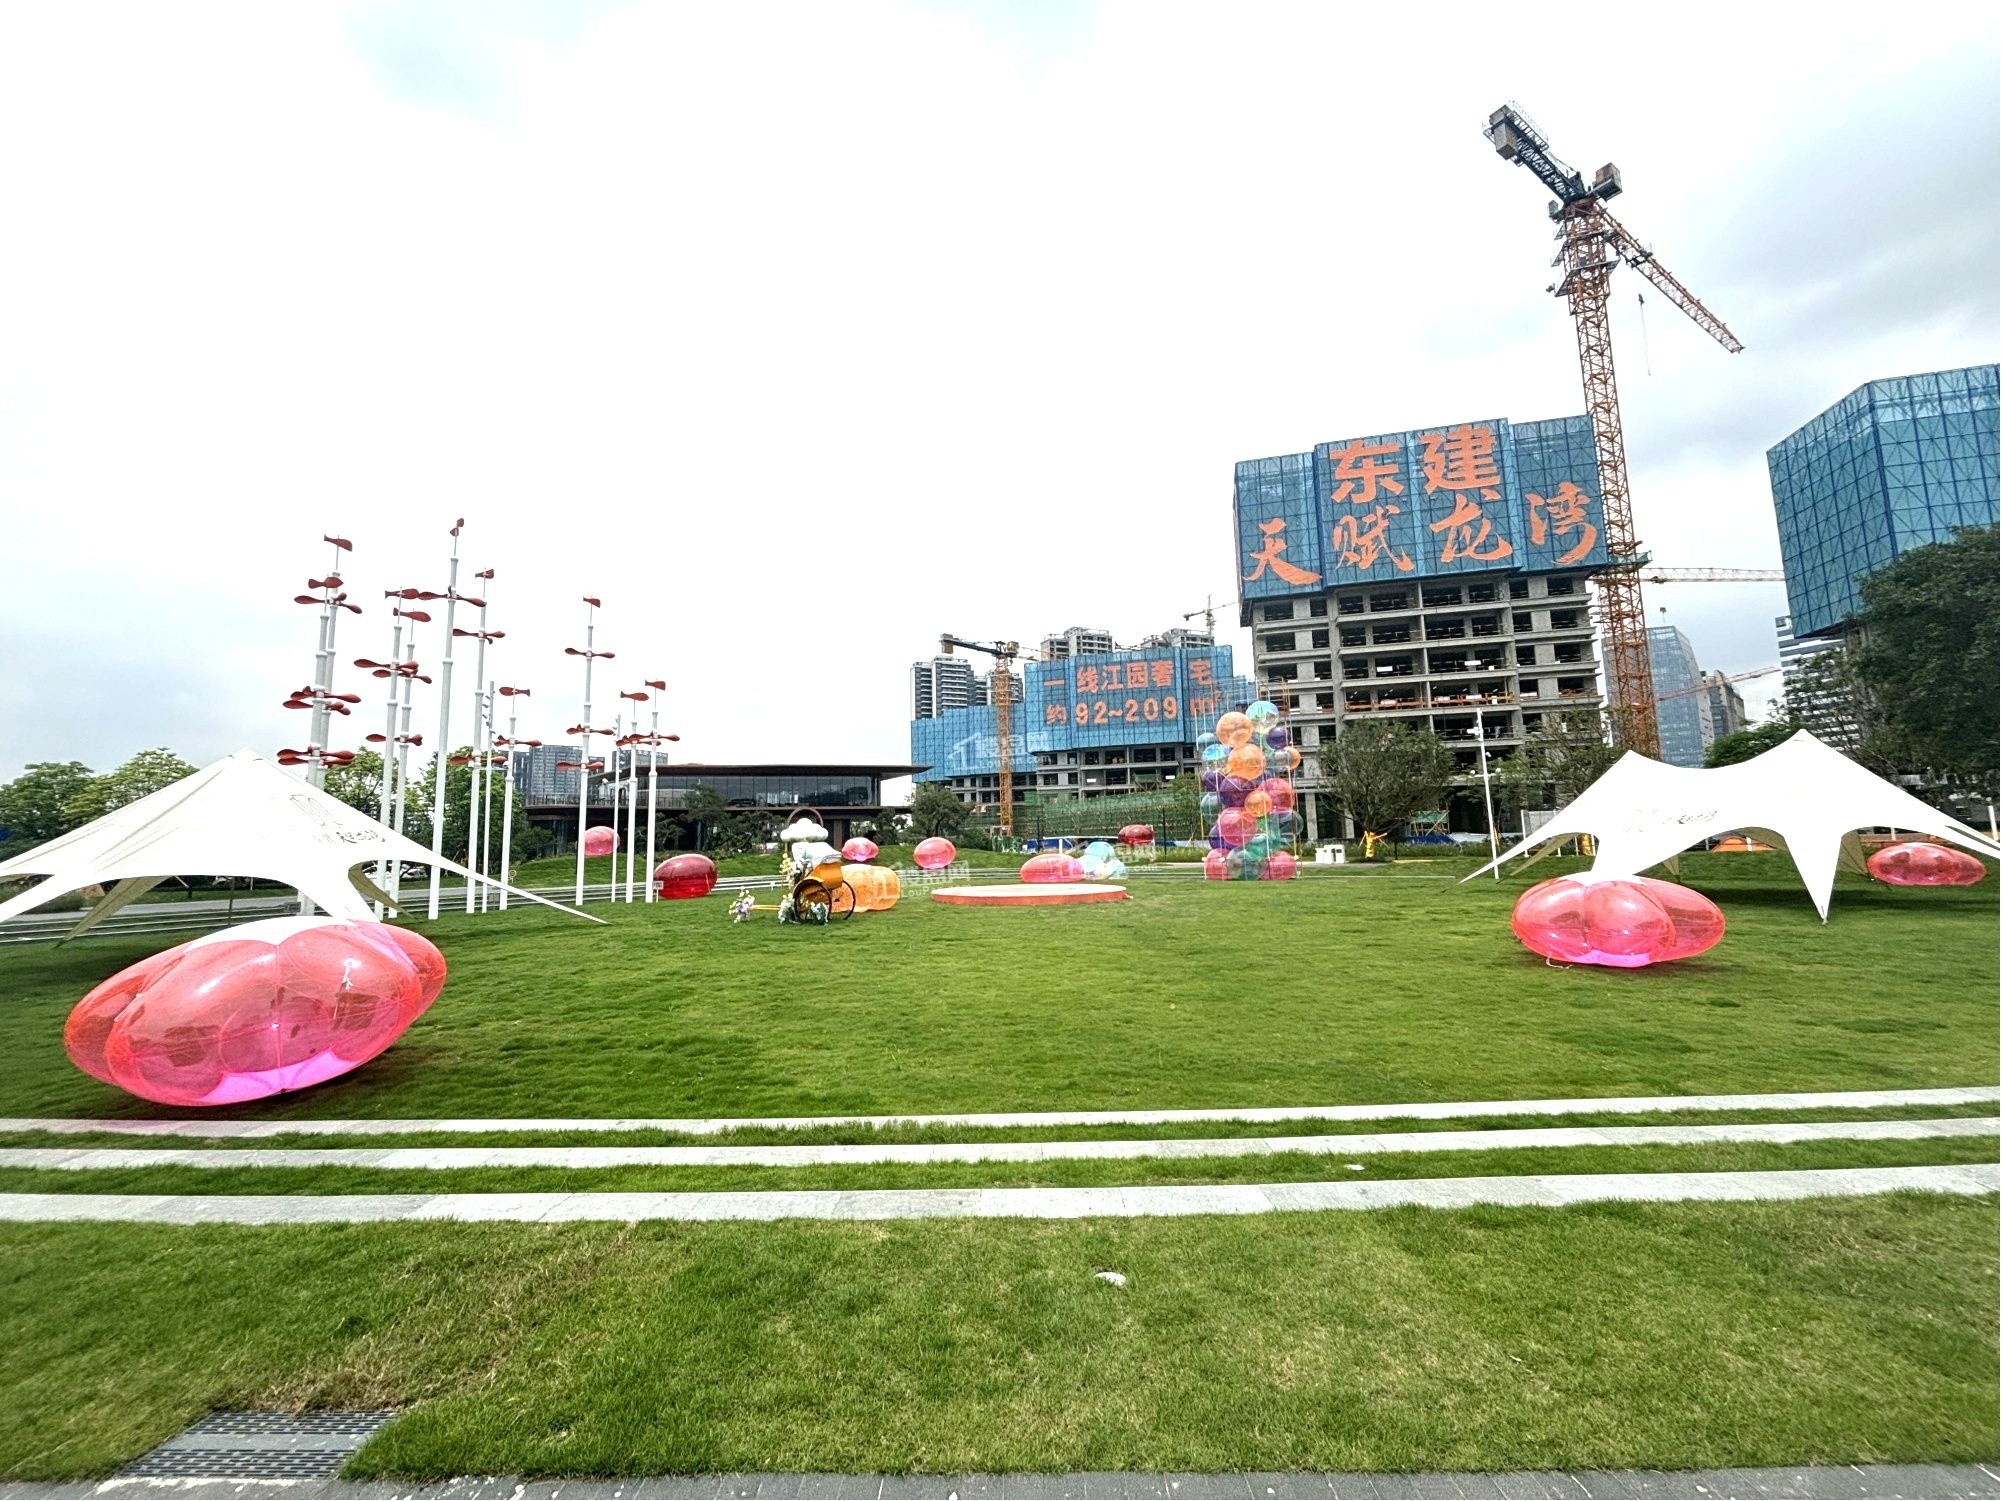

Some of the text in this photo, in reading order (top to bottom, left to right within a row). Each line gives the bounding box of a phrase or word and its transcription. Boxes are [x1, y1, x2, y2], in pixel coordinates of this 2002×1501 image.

[1328, 423, 1502, 504] 东建
[1242, 480, 1598, 586] 天赋龙湾
[1043, 658, 1213, 694] 一线江园奢宅
